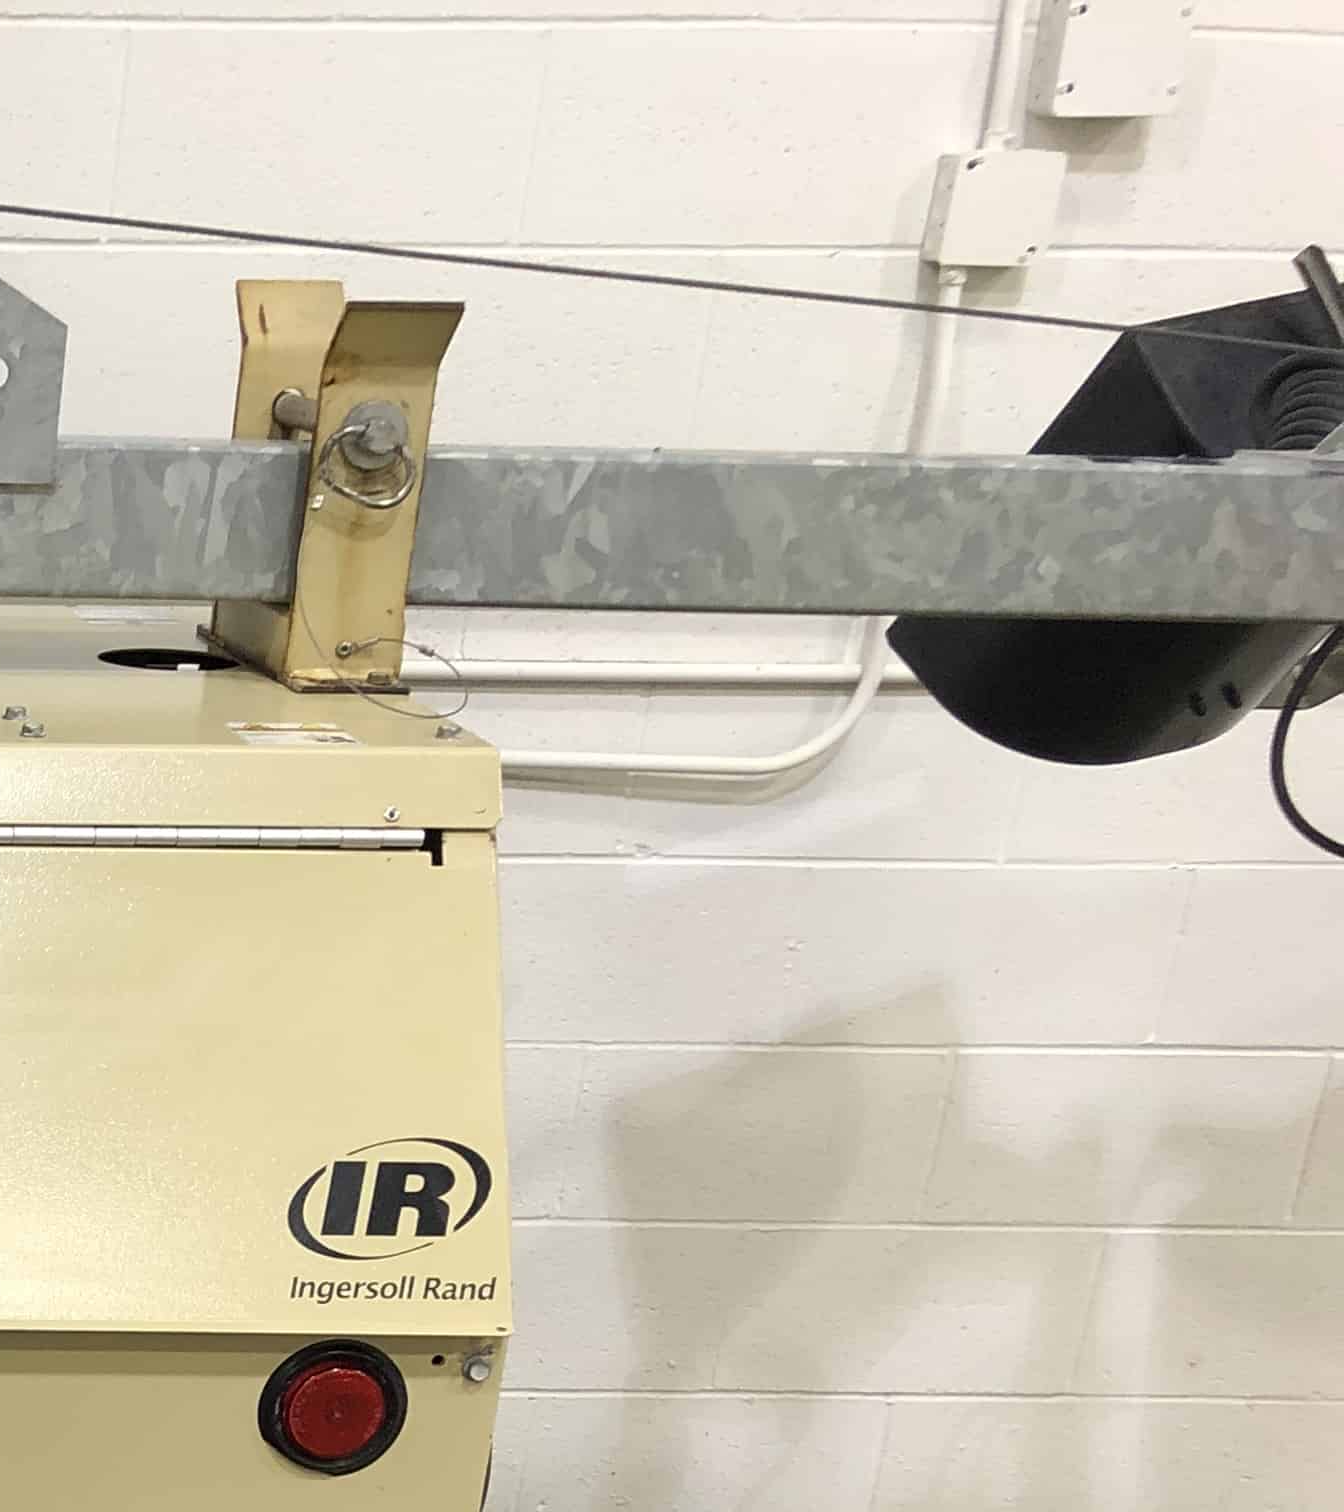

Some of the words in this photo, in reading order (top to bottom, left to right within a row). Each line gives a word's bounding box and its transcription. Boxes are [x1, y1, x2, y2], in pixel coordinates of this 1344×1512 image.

[320, 1160, 456, 1237] IR
[289, 1274, 416, 1305] Ingersoll
[422, 1275, 497, 1301] Rand
